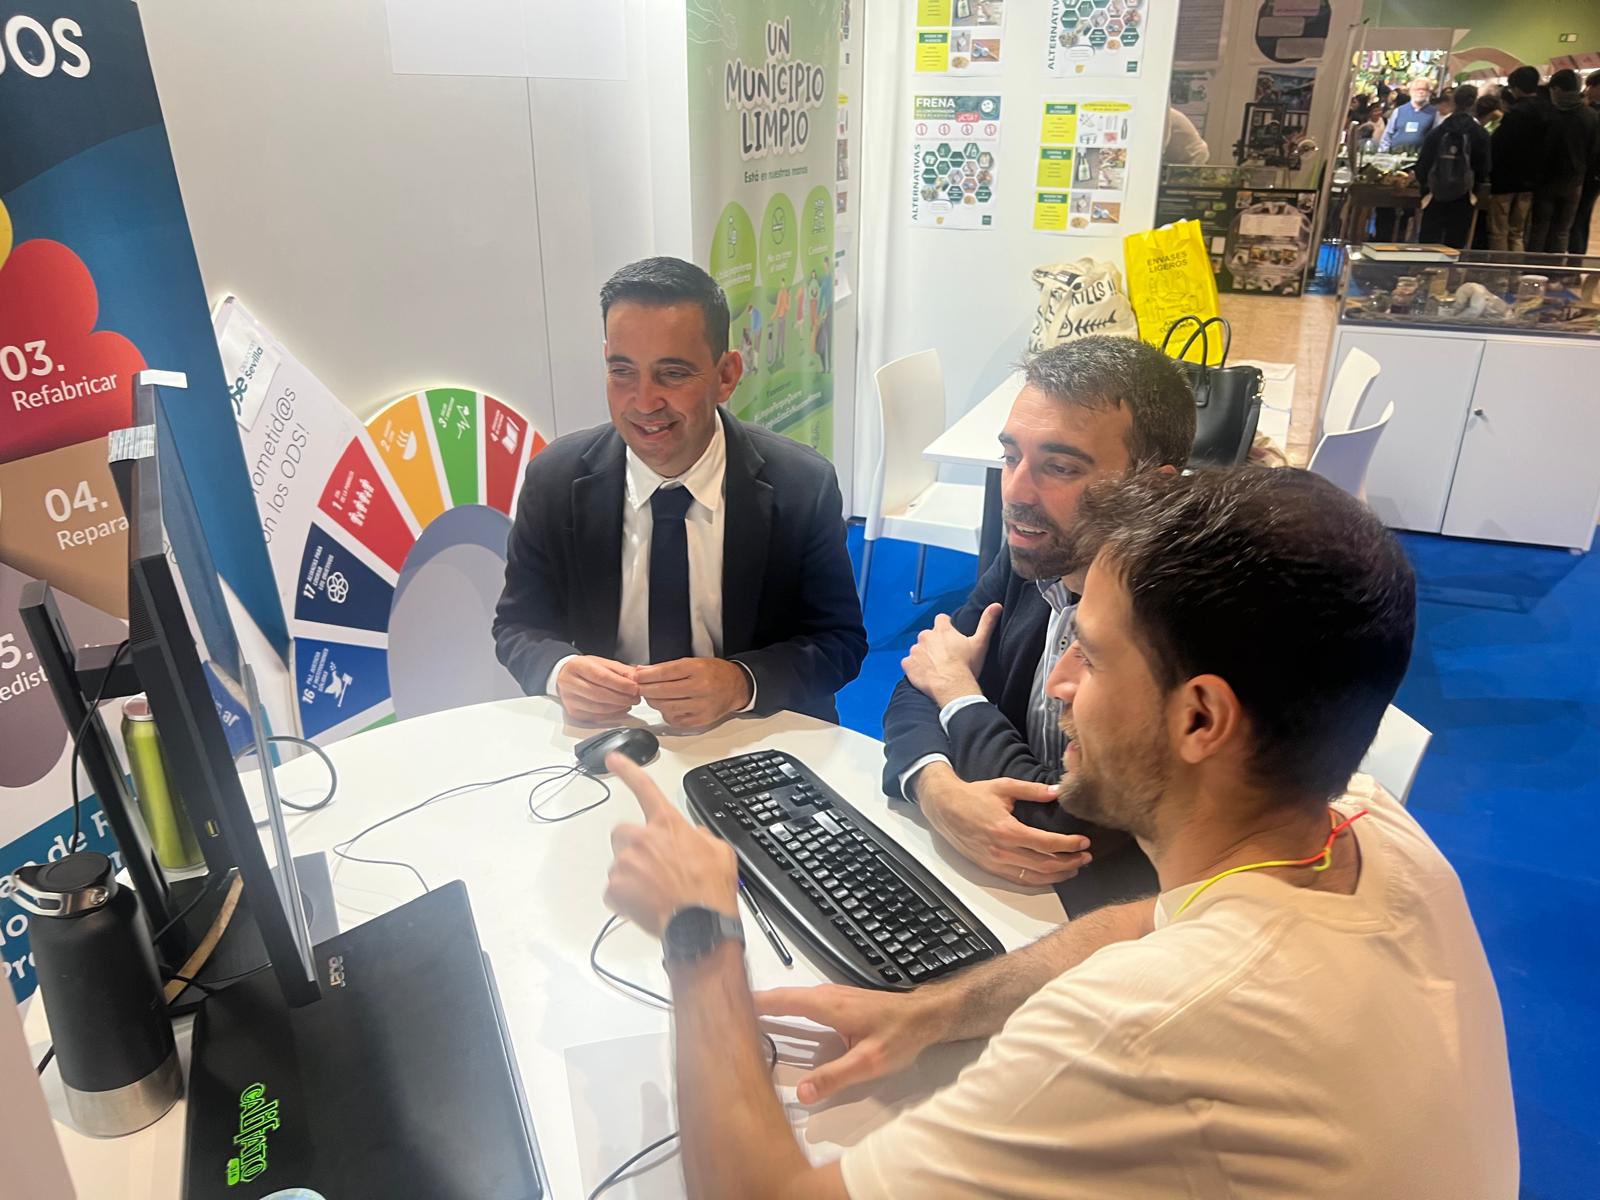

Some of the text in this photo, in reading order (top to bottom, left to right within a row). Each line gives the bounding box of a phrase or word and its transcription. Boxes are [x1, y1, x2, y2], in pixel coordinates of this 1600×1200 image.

[0, 15, 91, 78] OS
[767, 18, 790, 55] UN
[726, 61, 824, 104] MUNICIPIO
[916, 97, 956, 108] FRENA
[742, 107, 809, 154] LIMPIO
[912, 143, 920, 221] ALTERNATIVAS
[1147, 250, 1188, 266] ENVASES
[1149, 259, 1188, 273] LIGEROS
[0, 340, 65, 382] 03.
[245, 347, 263, 380] Sevilla
[11, 374, 118, 412] Refabricar
[267, 483, 289, 515] los
[280, 423, 310, 479] ODS!
[44, 480, 109, 522] 04.
[303, 583, 316, 599] 17
[302, 688, 315, 704] 16
